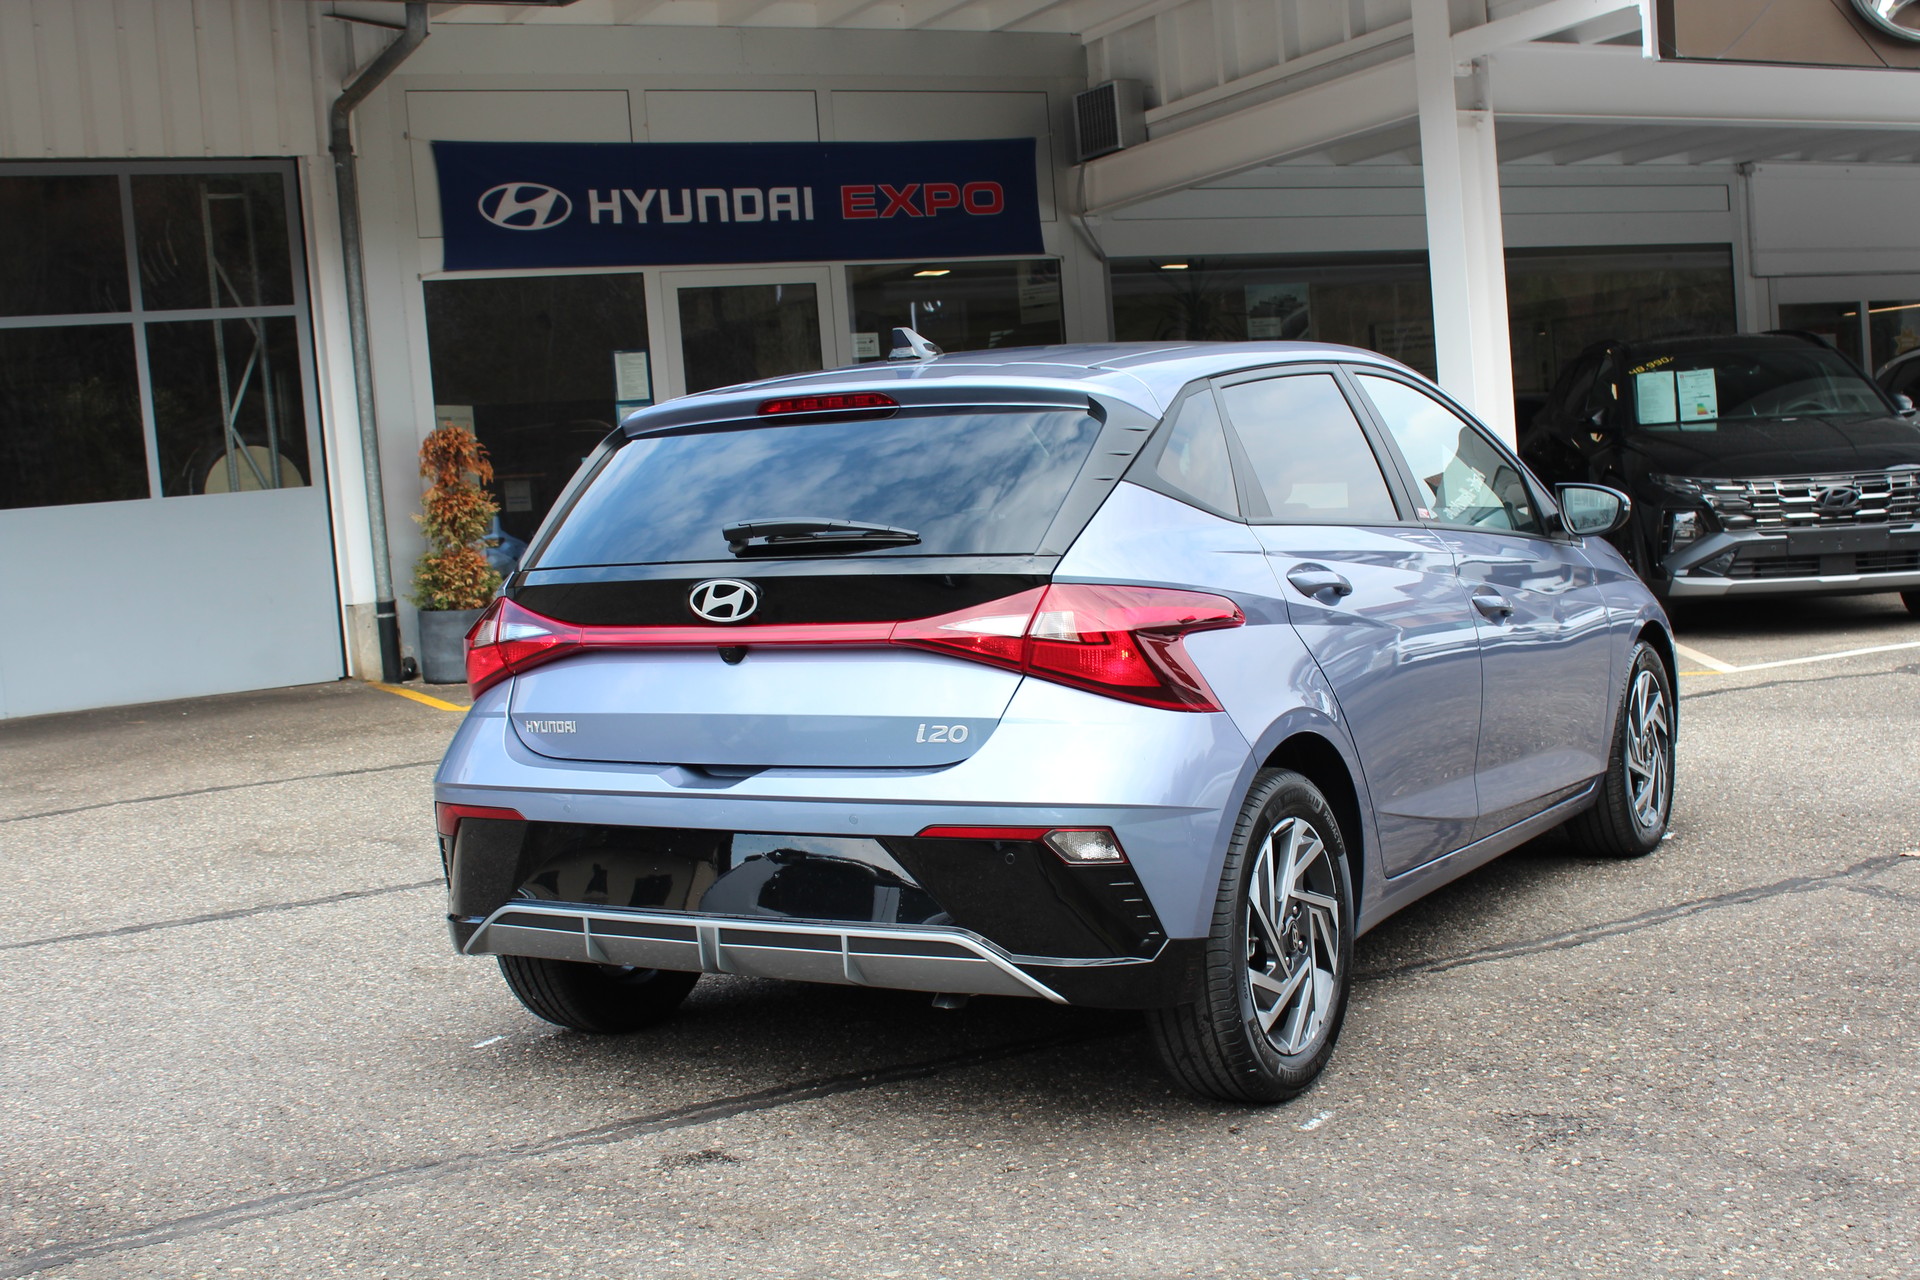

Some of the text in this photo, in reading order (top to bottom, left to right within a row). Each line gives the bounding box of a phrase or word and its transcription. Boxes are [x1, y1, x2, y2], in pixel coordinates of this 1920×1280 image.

[588, 181, 1005, 224] HYUNDAI EXPO
[526, 720, 577, 733] HYUNDAI
[916, 723, 969, 744] i20
[1323, 810, 1341, 843] PRIMACY
